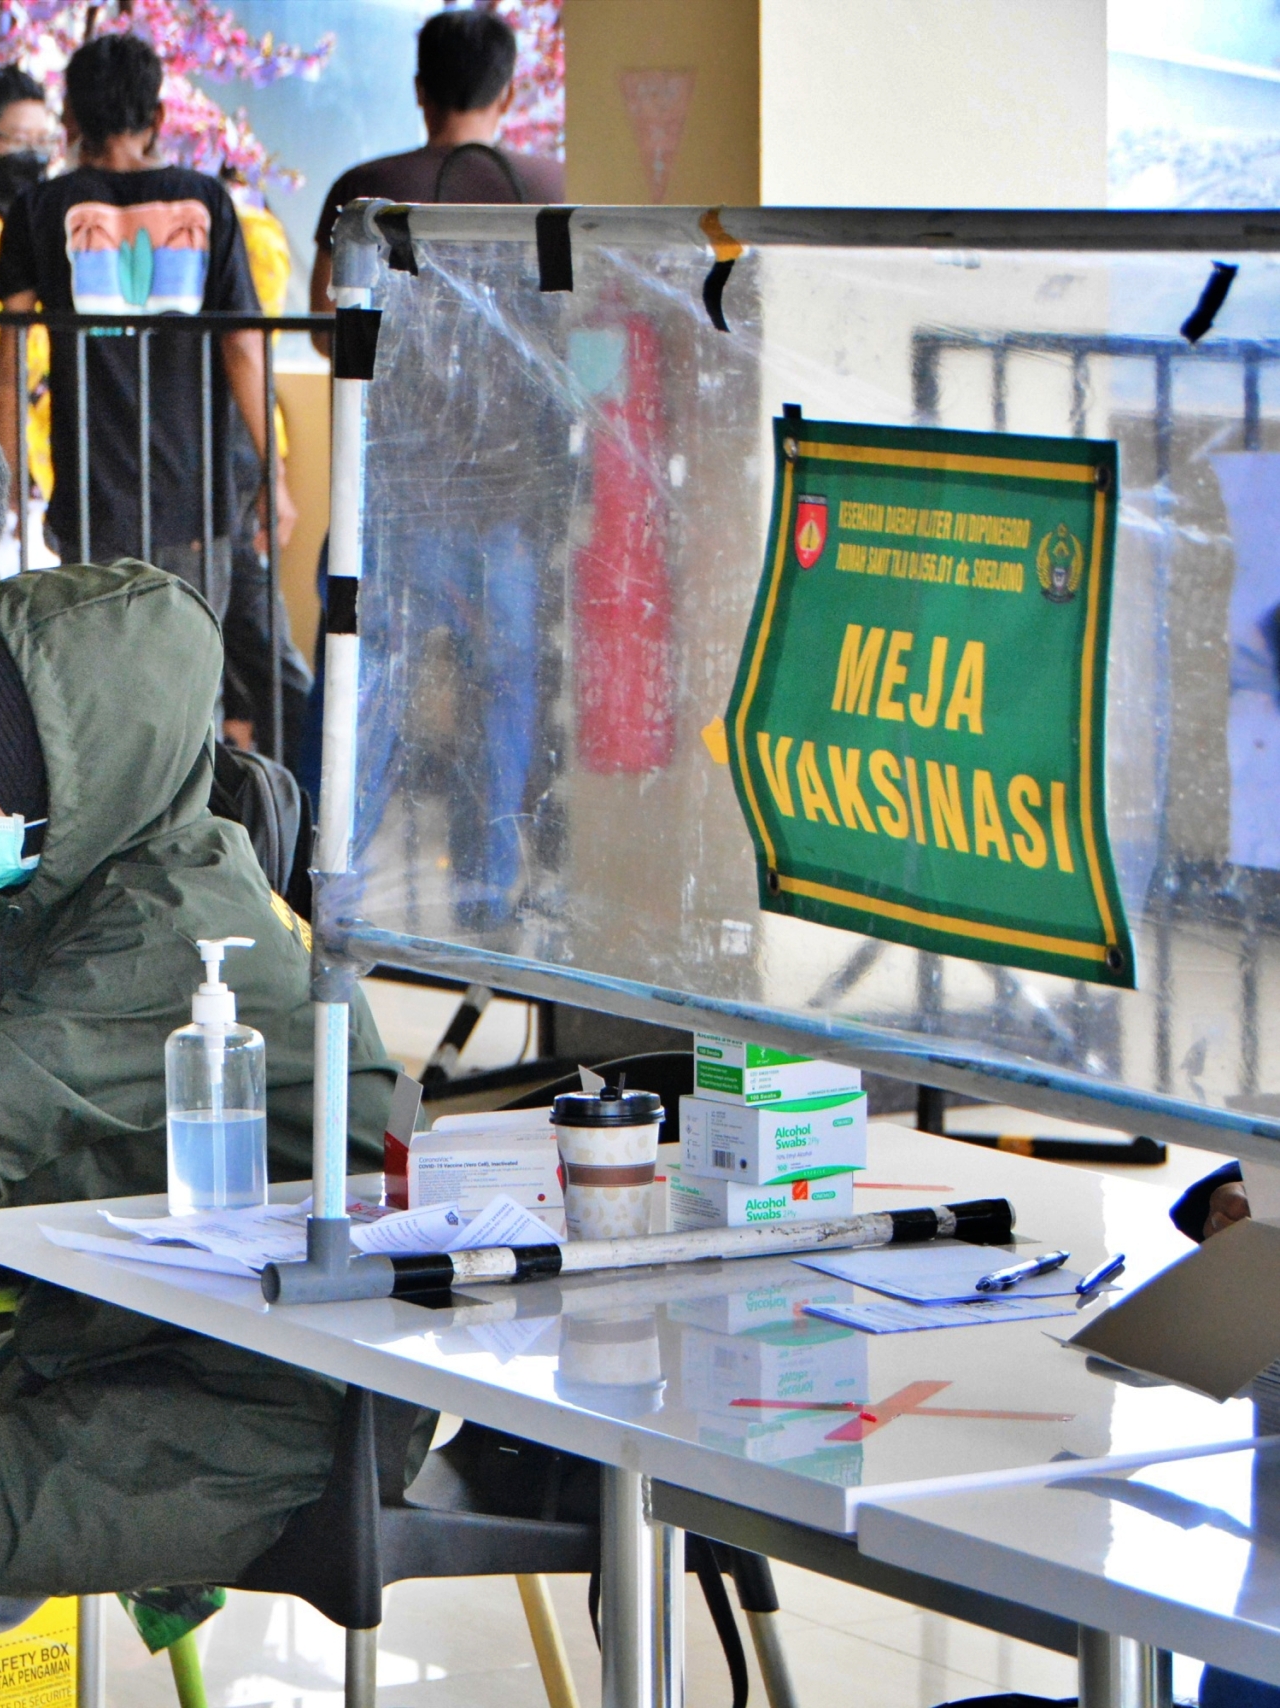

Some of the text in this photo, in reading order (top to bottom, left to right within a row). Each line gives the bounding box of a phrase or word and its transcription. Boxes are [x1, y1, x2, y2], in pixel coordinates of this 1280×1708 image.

[830, 623, 985, 735] MEJA
[756, 732, 1074, 874] VAKSINASI
[774, 1123, 811, 1139] Alcohol
[776, 1136, 807, 1150] Swabs
[745, 1196, 787, 1211] Alcohol
[746, 1208, 782, 1222] Swabs
[40, 1642, 69, 1662] BOX
[18, 1658, 70, 1684] PENGAMAN
